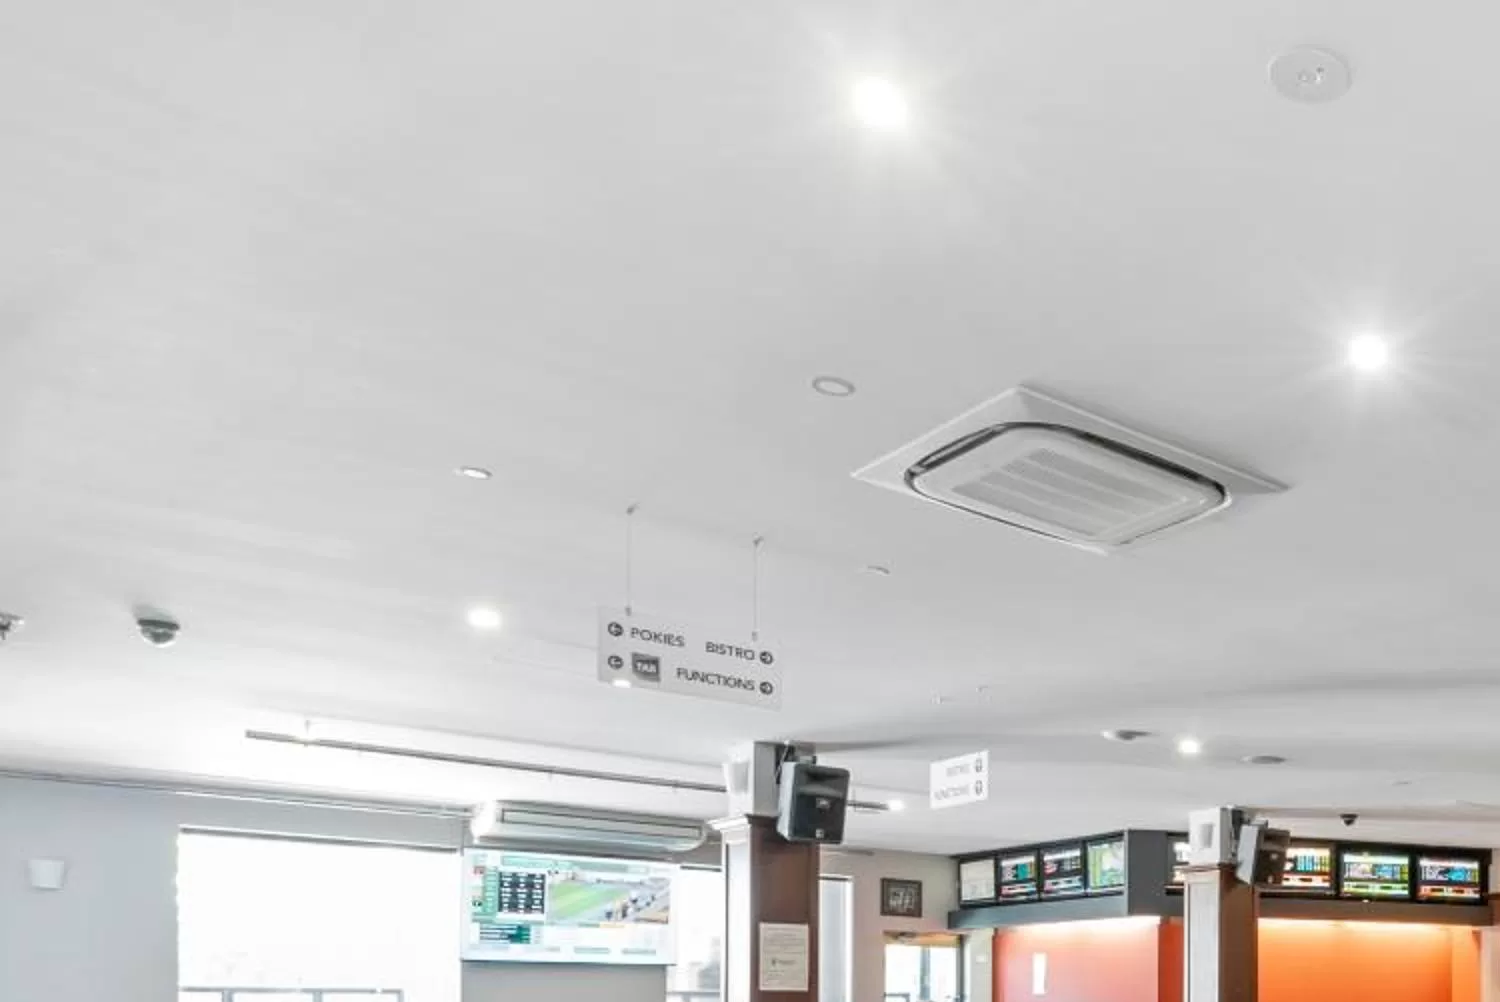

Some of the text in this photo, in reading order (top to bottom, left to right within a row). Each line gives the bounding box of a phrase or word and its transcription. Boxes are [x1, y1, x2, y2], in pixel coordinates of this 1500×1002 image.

[631, 627, 685, 647] POKIES
[705, 641, 755, 661] BISTRO
[676, 667, 755, 691] FUNCTIONS
